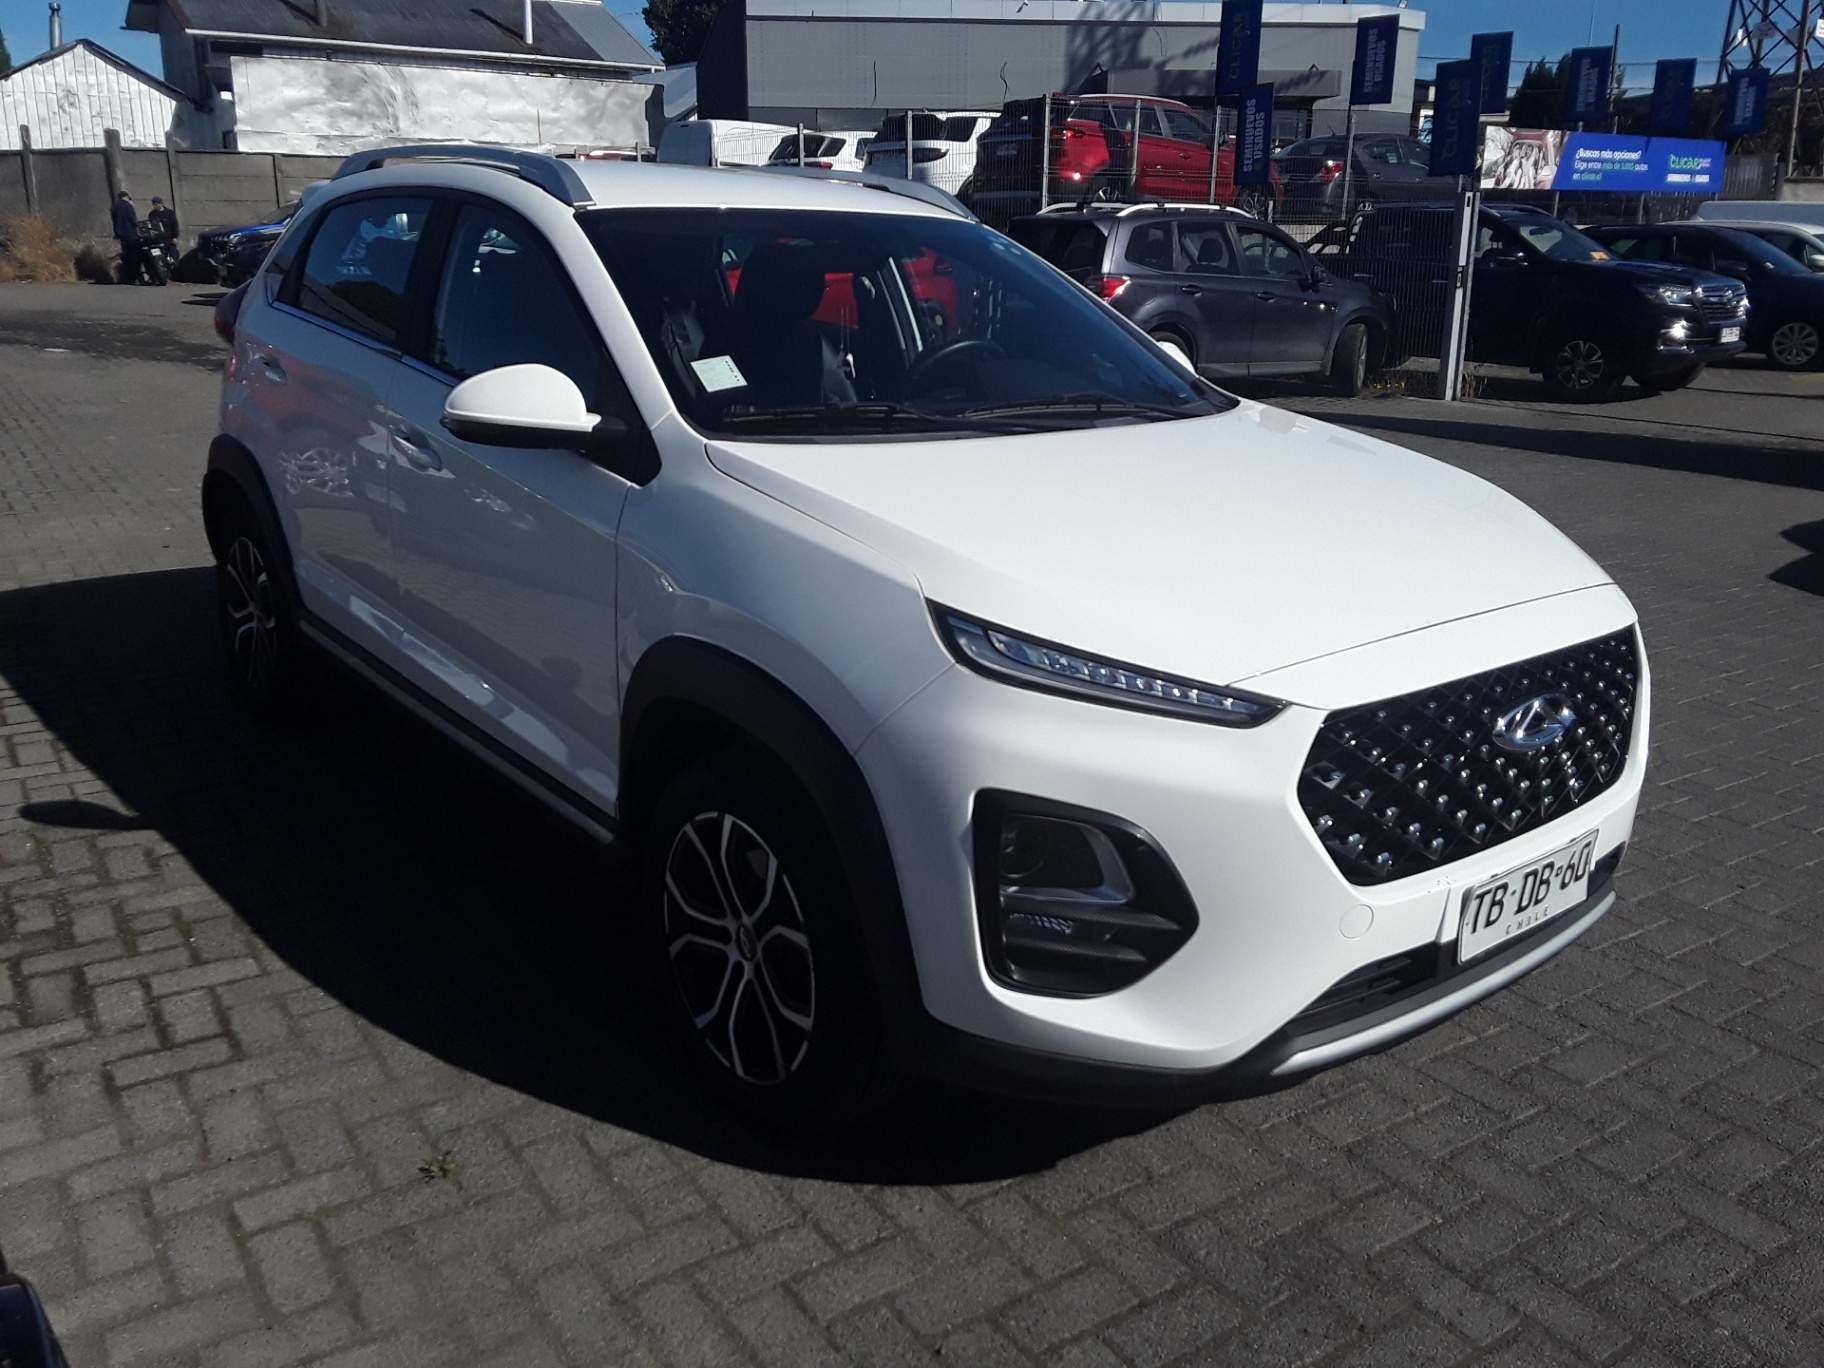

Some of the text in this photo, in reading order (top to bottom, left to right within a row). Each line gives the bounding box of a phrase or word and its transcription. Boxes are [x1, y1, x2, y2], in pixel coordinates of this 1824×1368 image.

[1243, 97, 1257, 172] SEMINUEVOS
[1253, 111, 1265, 160] USADOS
[1576, 148, 1600, 159] ¿Buscas
[1506, 907, 1549, 934] CHILE
